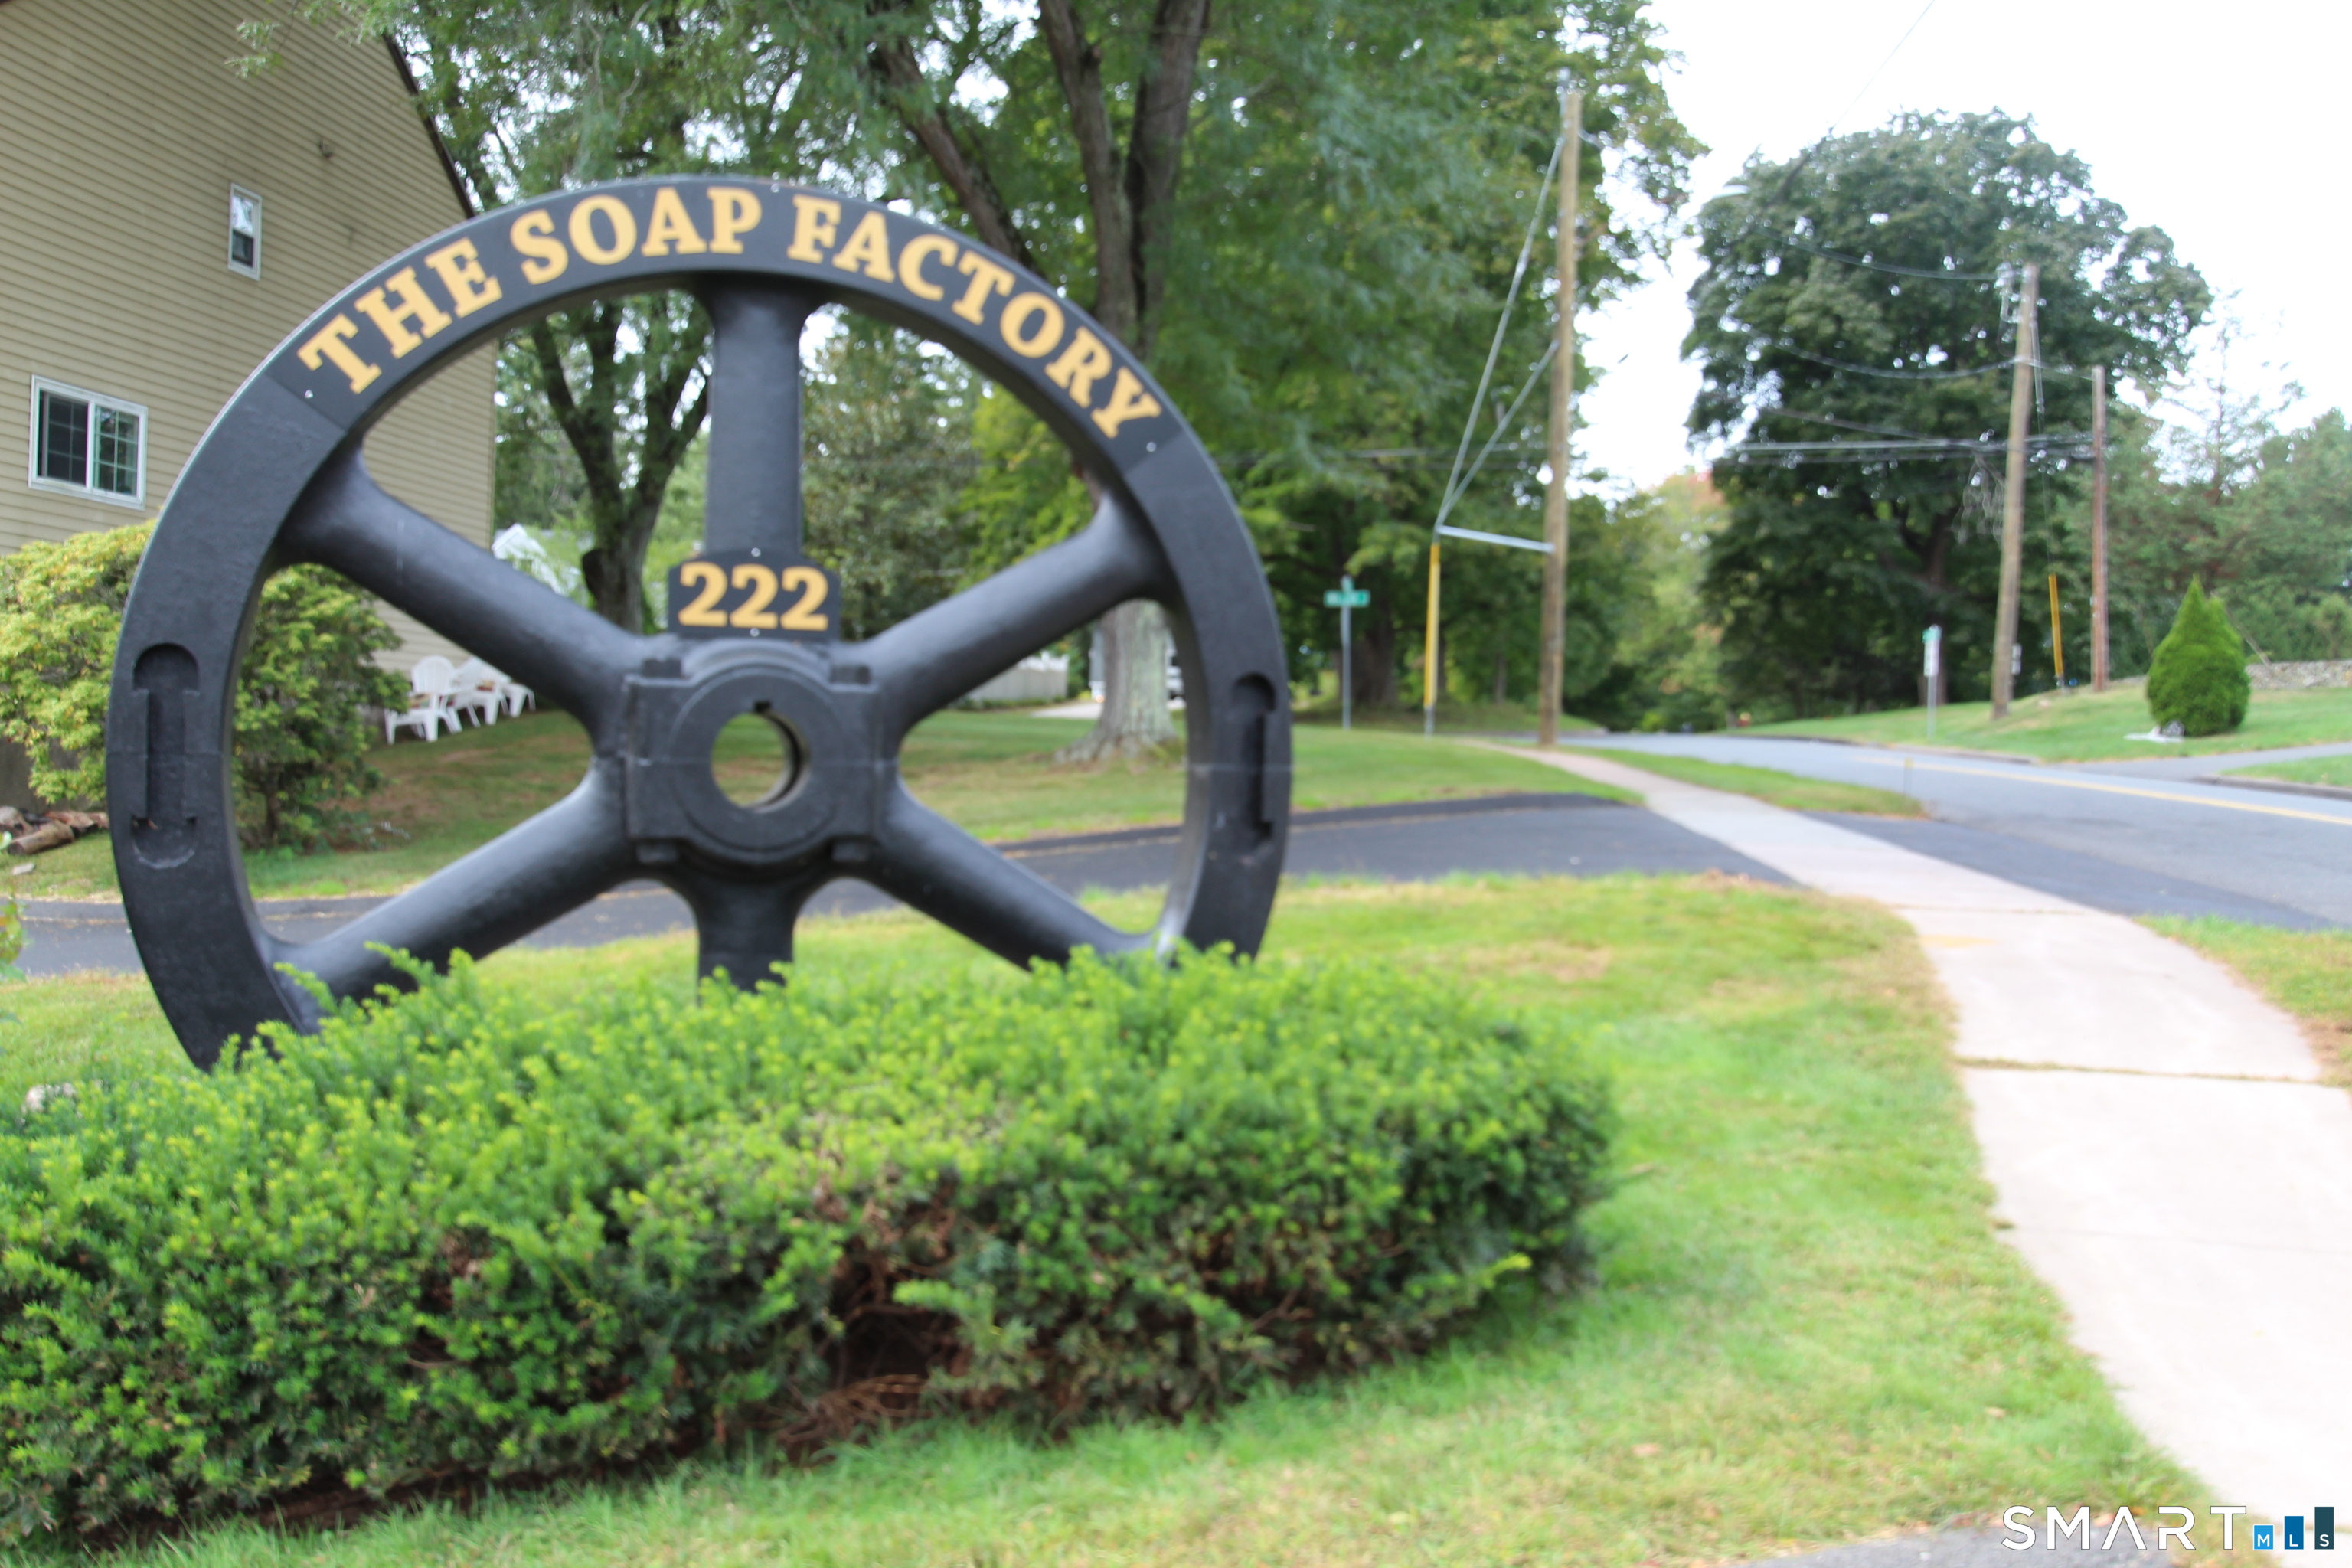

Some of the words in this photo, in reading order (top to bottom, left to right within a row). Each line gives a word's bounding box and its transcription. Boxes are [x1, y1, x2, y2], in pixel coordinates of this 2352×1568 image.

[296, 237, 503, 394] THE
[510, 186, 763, 285] SOAP
[787, 194, 1162, 439] FACTORY
[678, 561, 829, 632] 222
